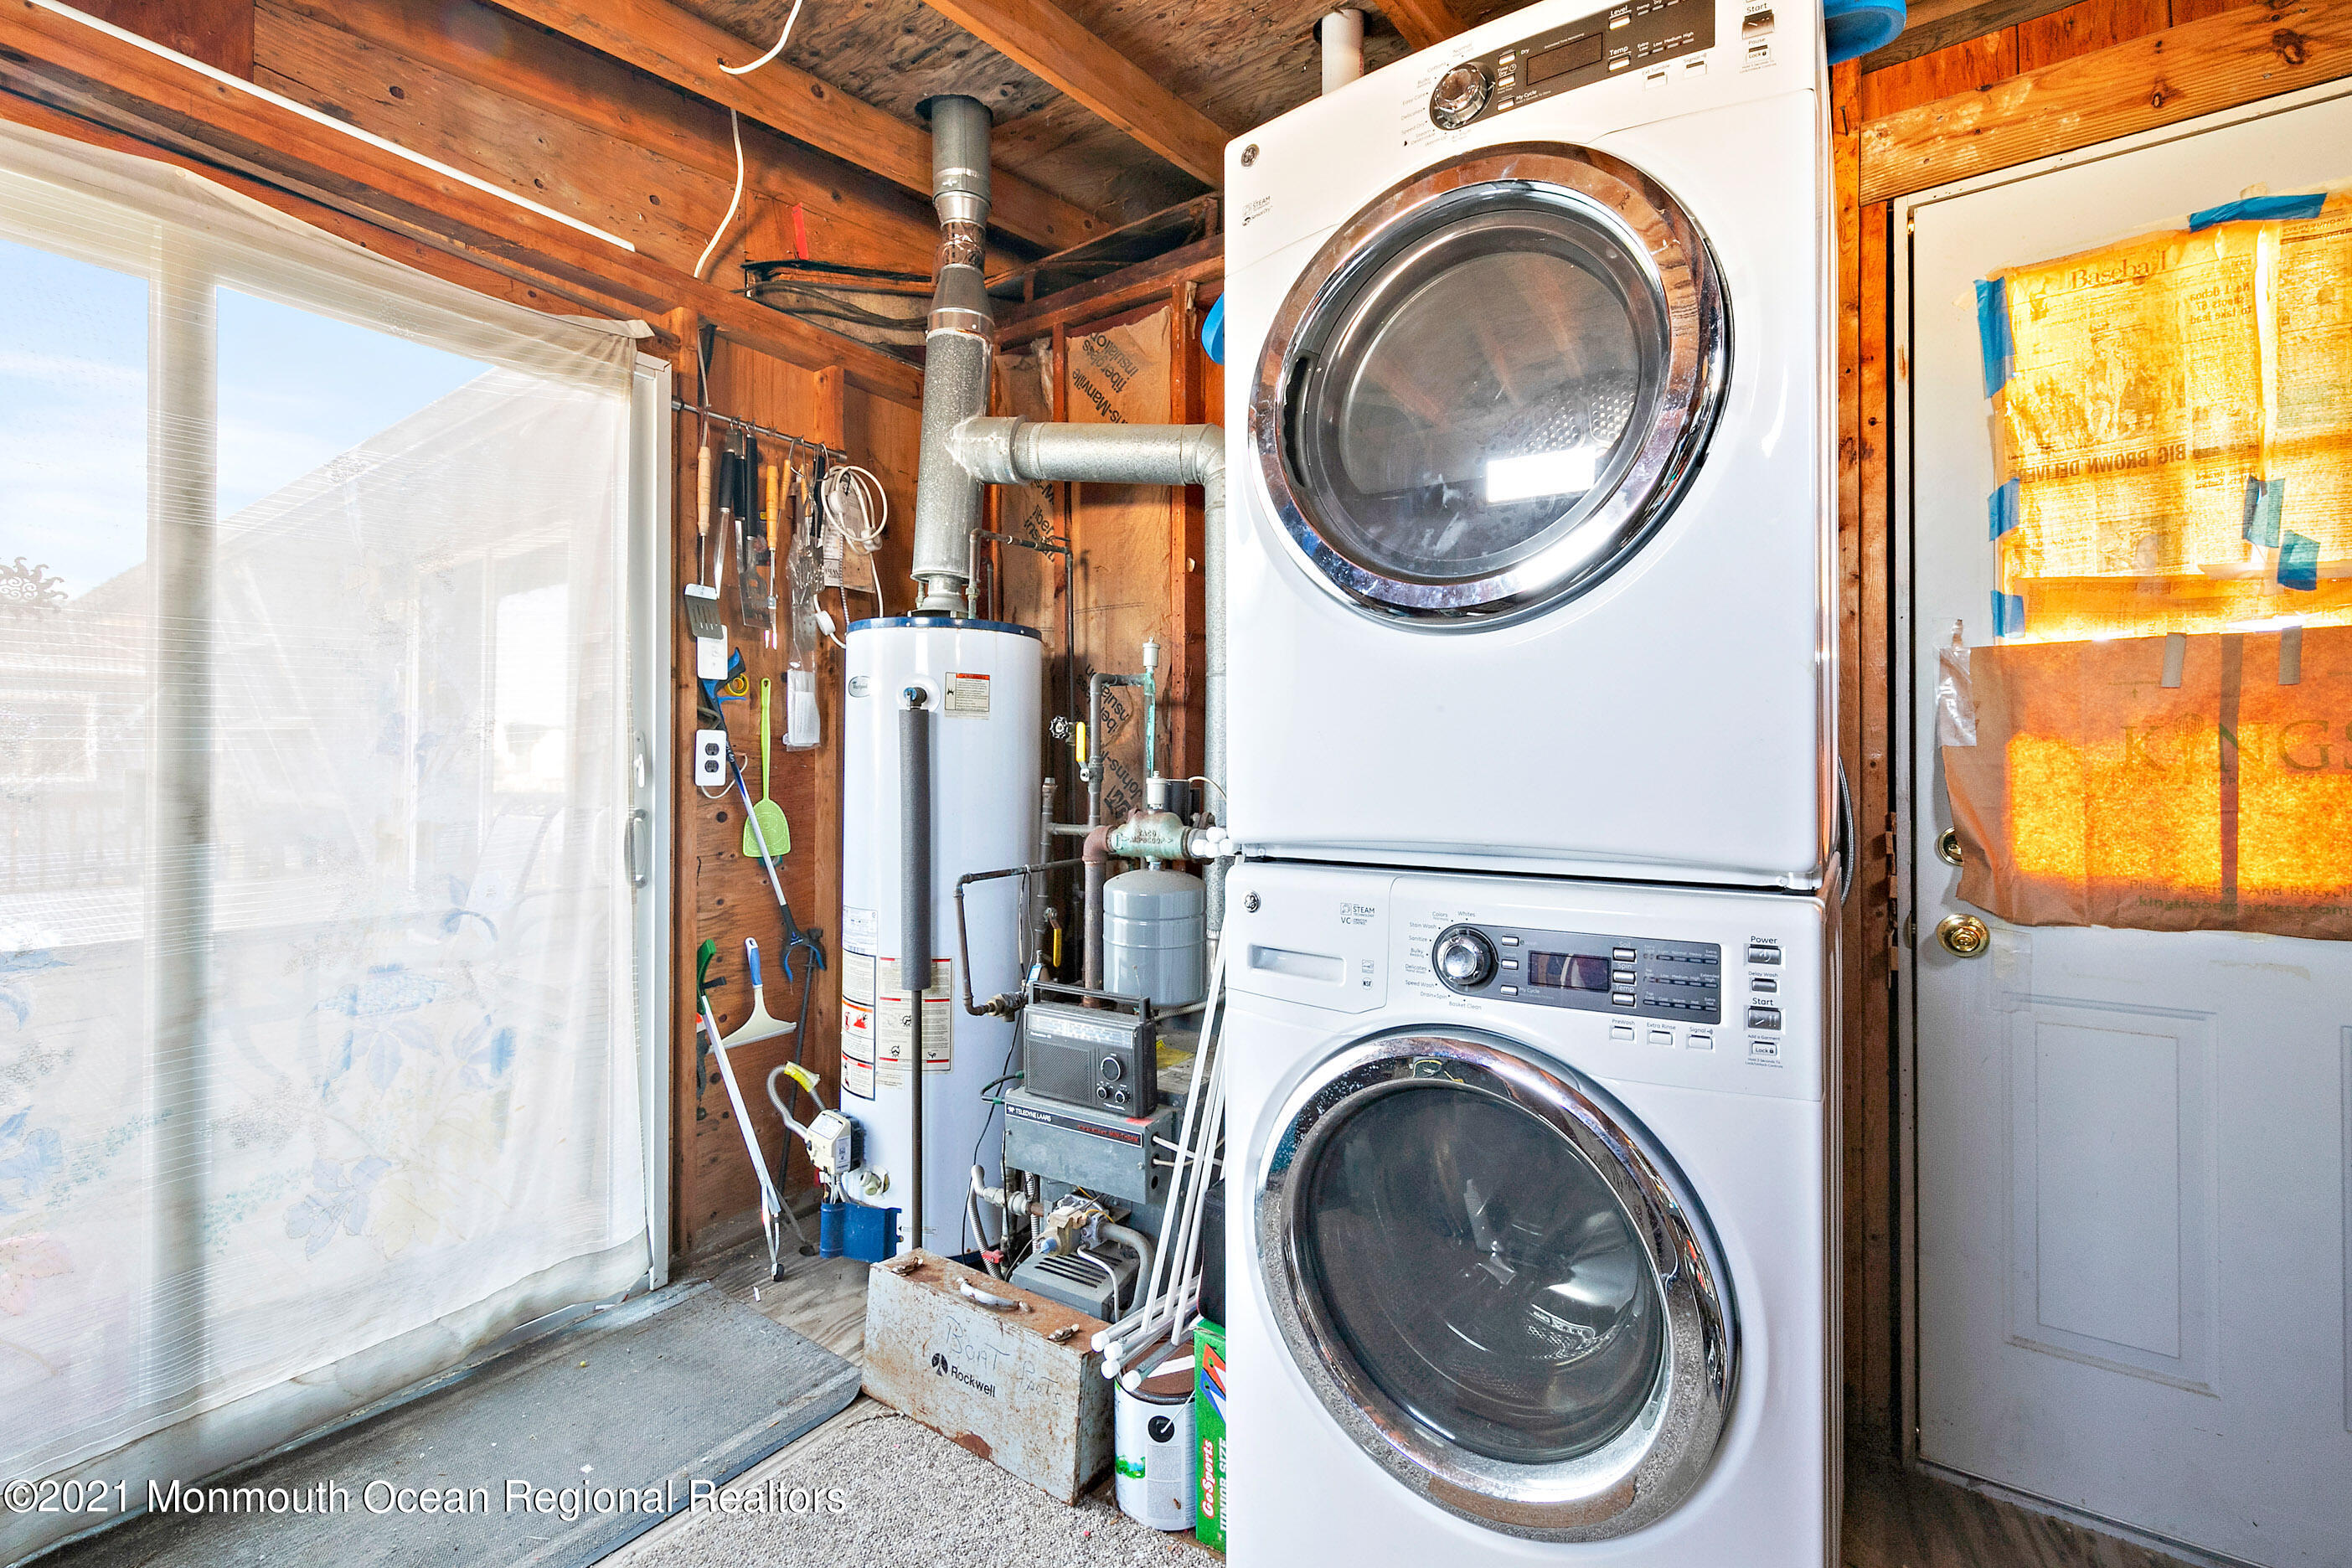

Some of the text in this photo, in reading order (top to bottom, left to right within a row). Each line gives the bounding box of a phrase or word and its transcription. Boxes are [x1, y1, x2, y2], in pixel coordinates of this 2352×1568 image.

[1610, 5, 1628, 17] Level
[1746, 3, 1767, 14] Start
[1609, 45, 1629, 56] Temp
[2129, 879, 2179, 893] Please
[2248, 886, 2282, 897] And
[1750, 936, 1778, 944] Power
[1411, 947, 1424, 956] Bulky
[1405, 979, 1420, 988] Speed
[1615, 984, 1635, 993] Temp
[1449, 1000, 1467, 1009] Basket
[1752, 997, 1774, 1006] Start
[952, 1365, 996, 1398] Rockwell
[1202, 1439, 1216, 1518] GoSports
